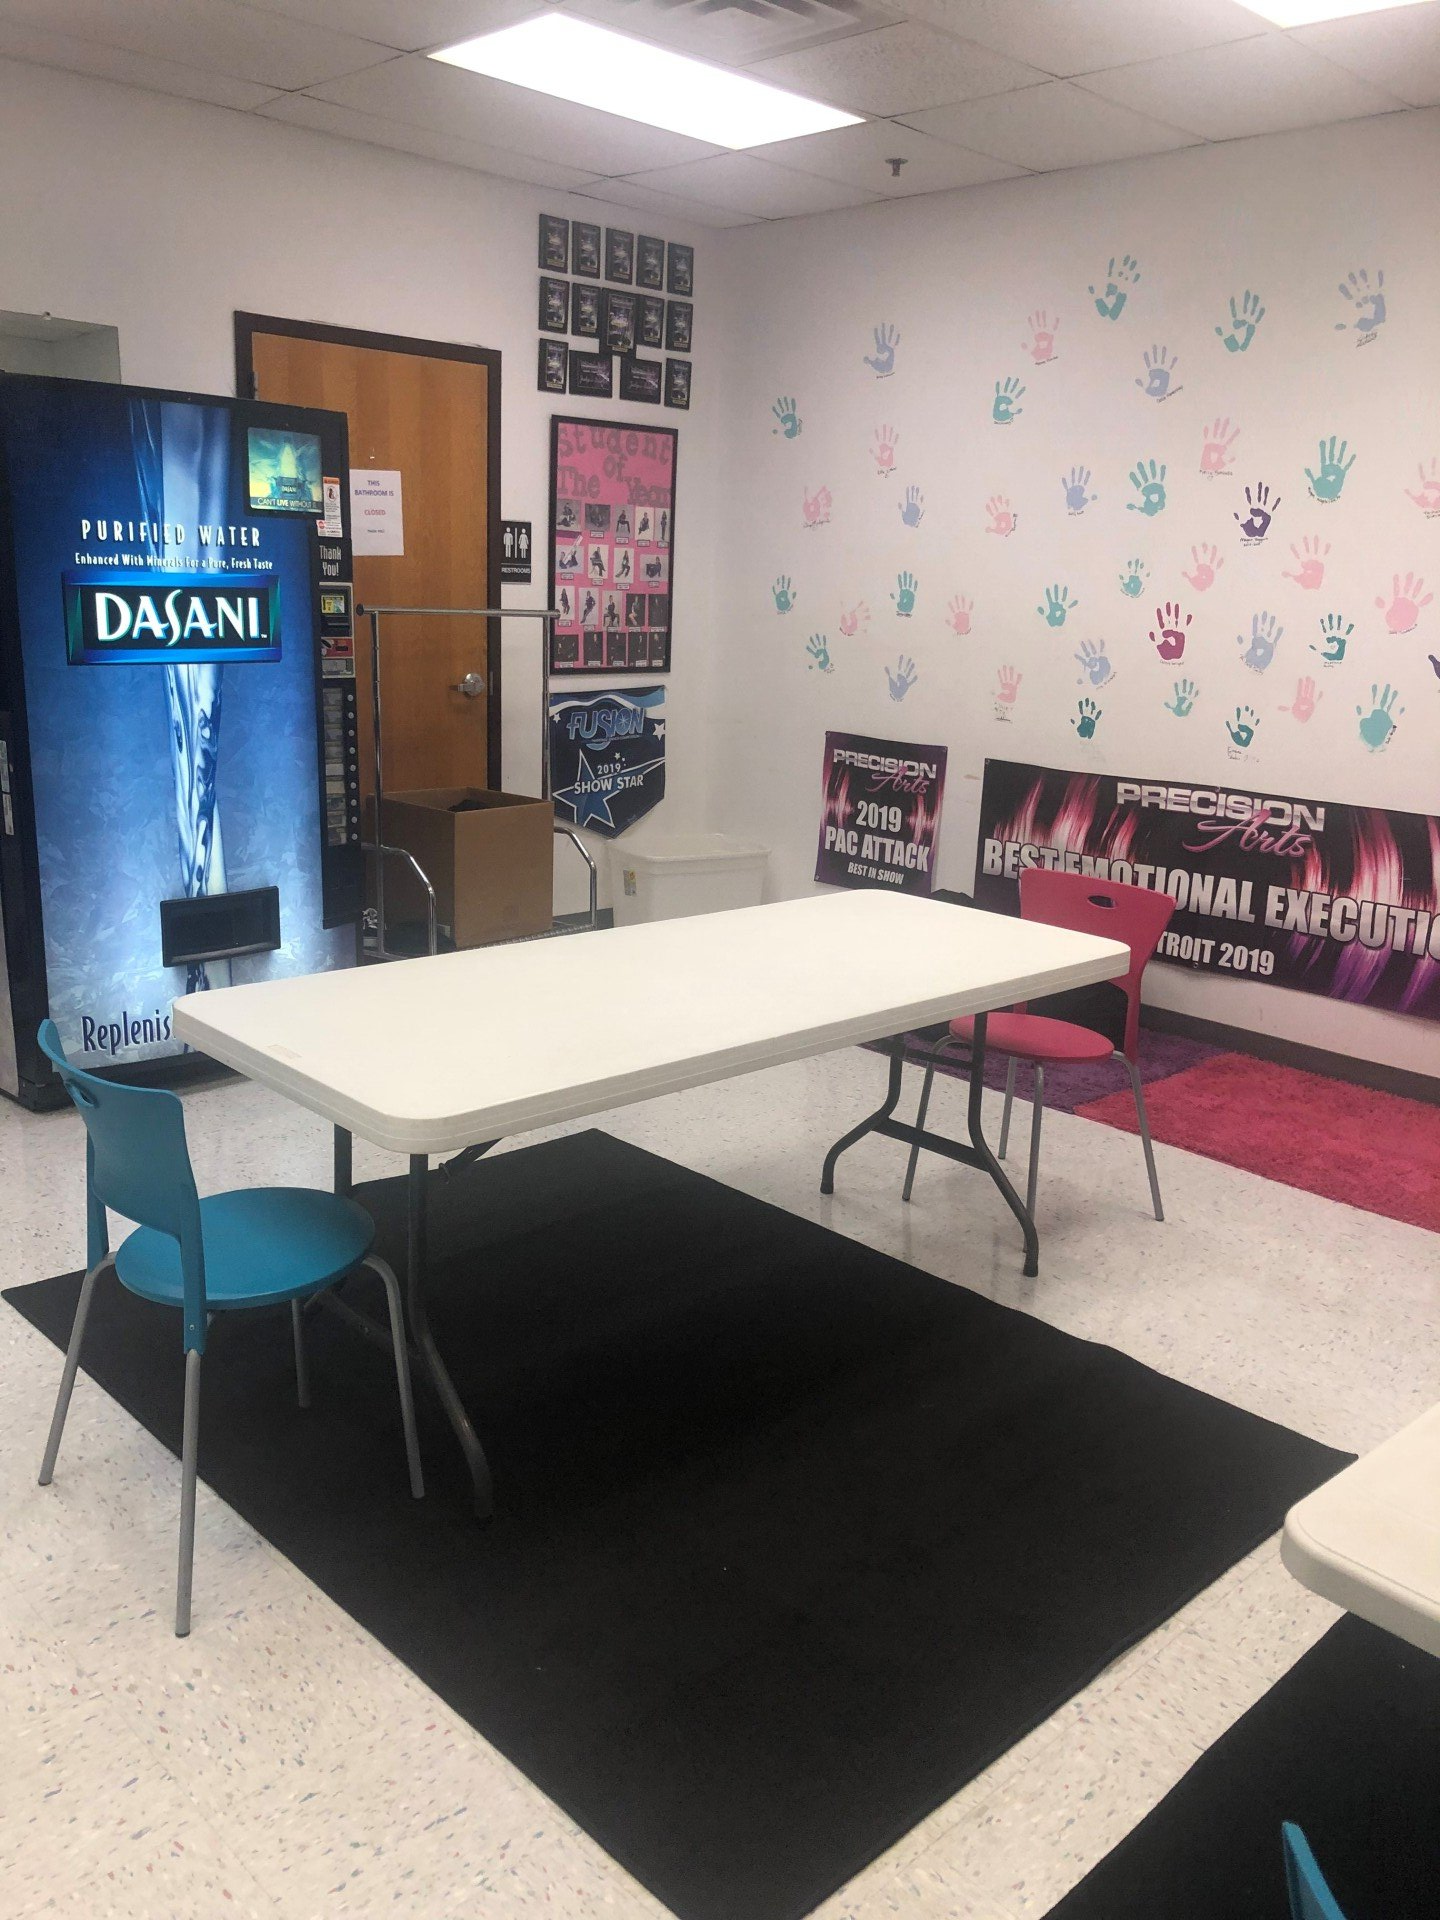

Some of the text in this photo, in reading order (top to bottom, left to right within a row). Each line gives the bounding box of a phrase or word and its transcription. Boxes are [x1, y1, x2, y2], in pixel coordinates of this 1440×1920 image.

[354, 489, 388, 497] BATHROOM
[558, 466, 600, 499] The
[276, 499, 289, 507] LIVE
[81, 519, 260, 547] PURIFIED WATER
[75, 552, 119, 566] Enhanced
[121, 554, 144, 567] With
[146, 554, 183, 568] Minerals
[185, 557, 199, 568] For
[201, 559, 207, 568] a
[231, 557, 252, 570] Fresh
[252, 558, 273, 570] Taste
[319, 545, 342, 561] Thank
[322, 561, 340, 577] You!
[95, 588, 260, 646] DASANI
[597, 763, 622, 775] 2019
[833, 748, 937, 780] PRECISION
[573, 774, 644, 795] SHOW STAR
[865, 767, 930, 794] Arts
[855, 800, 902, 833] 2019
[1116, 782, 1326, 832] PRECISION
[1182, 808, 1312, 858] Arts
[824, 826, 931, 873] PAC ATTACK
[847, 861, 905, 885] BEST IN SHOW
[982, 838, 1059, 880] BEST
[1065, 851, 1256, 924] EMOTIONAL
[1217, 943, 1275, 977] 2019
[81, 1008, 174, 1055] Replenis
